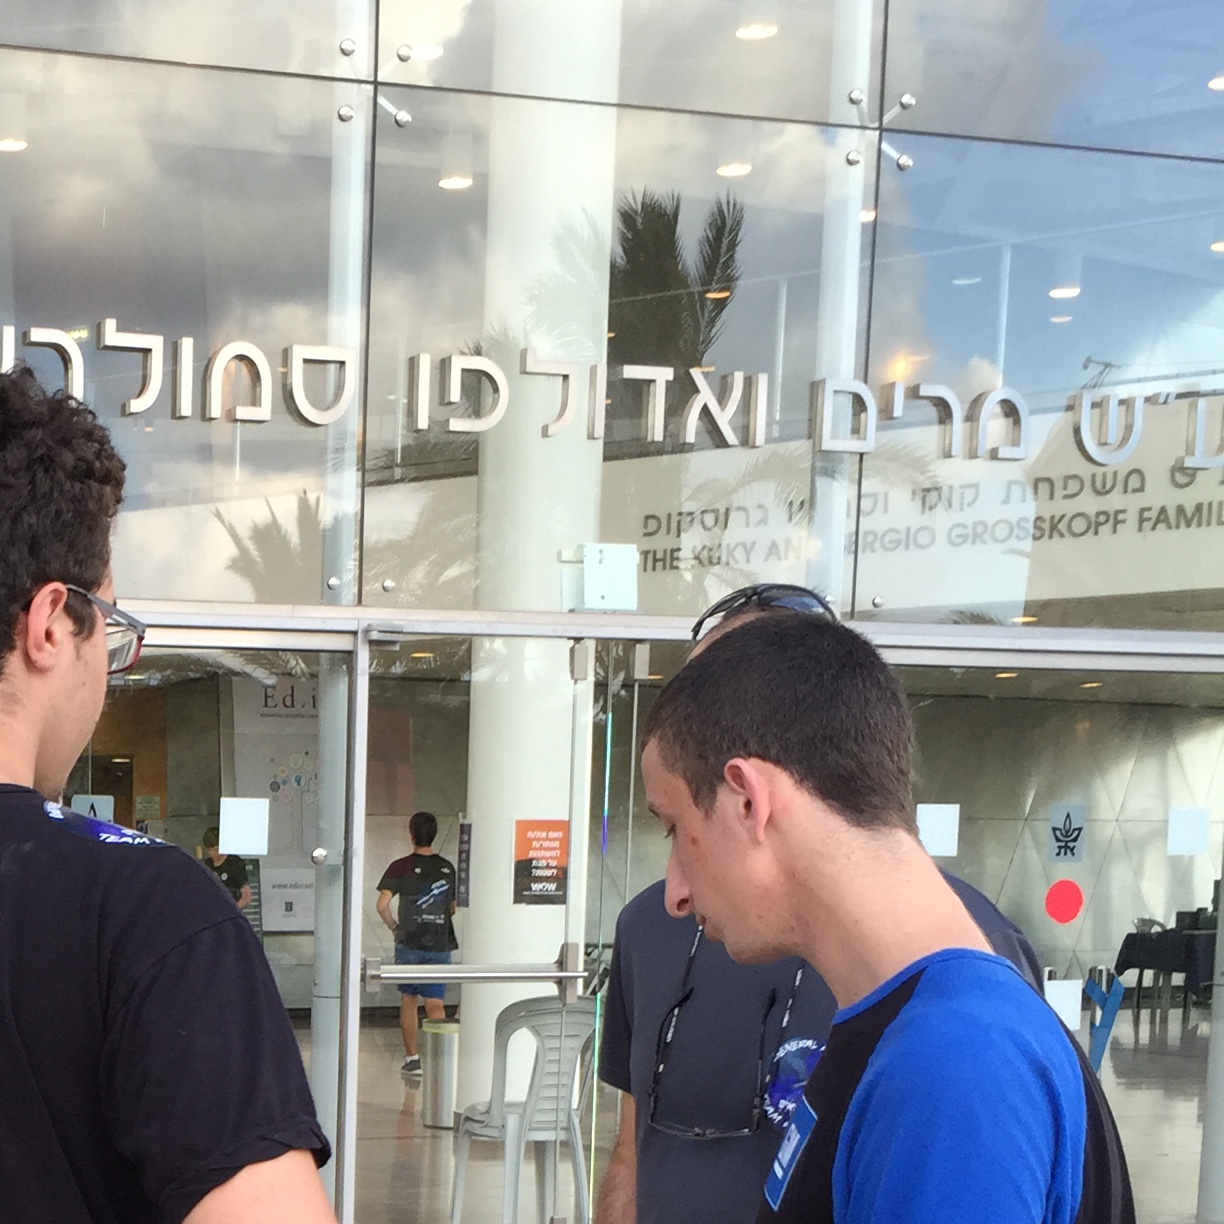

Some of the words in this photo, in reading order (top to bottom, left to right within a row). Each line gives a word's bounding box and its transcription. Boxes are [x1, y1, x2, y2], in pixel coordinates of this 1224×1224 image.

[409, 347, 769, 448] ואדולפו
[812, 377, 1030, 461] מרים
[1001, 467, 1147, 508] משפחת
[639, 548, 682, 573] THE
[843, 525, 936, 556] ERGIO
[946, 508, 1127, 548] GROSSKOPF
[530, 882, 557, 891] WOW
